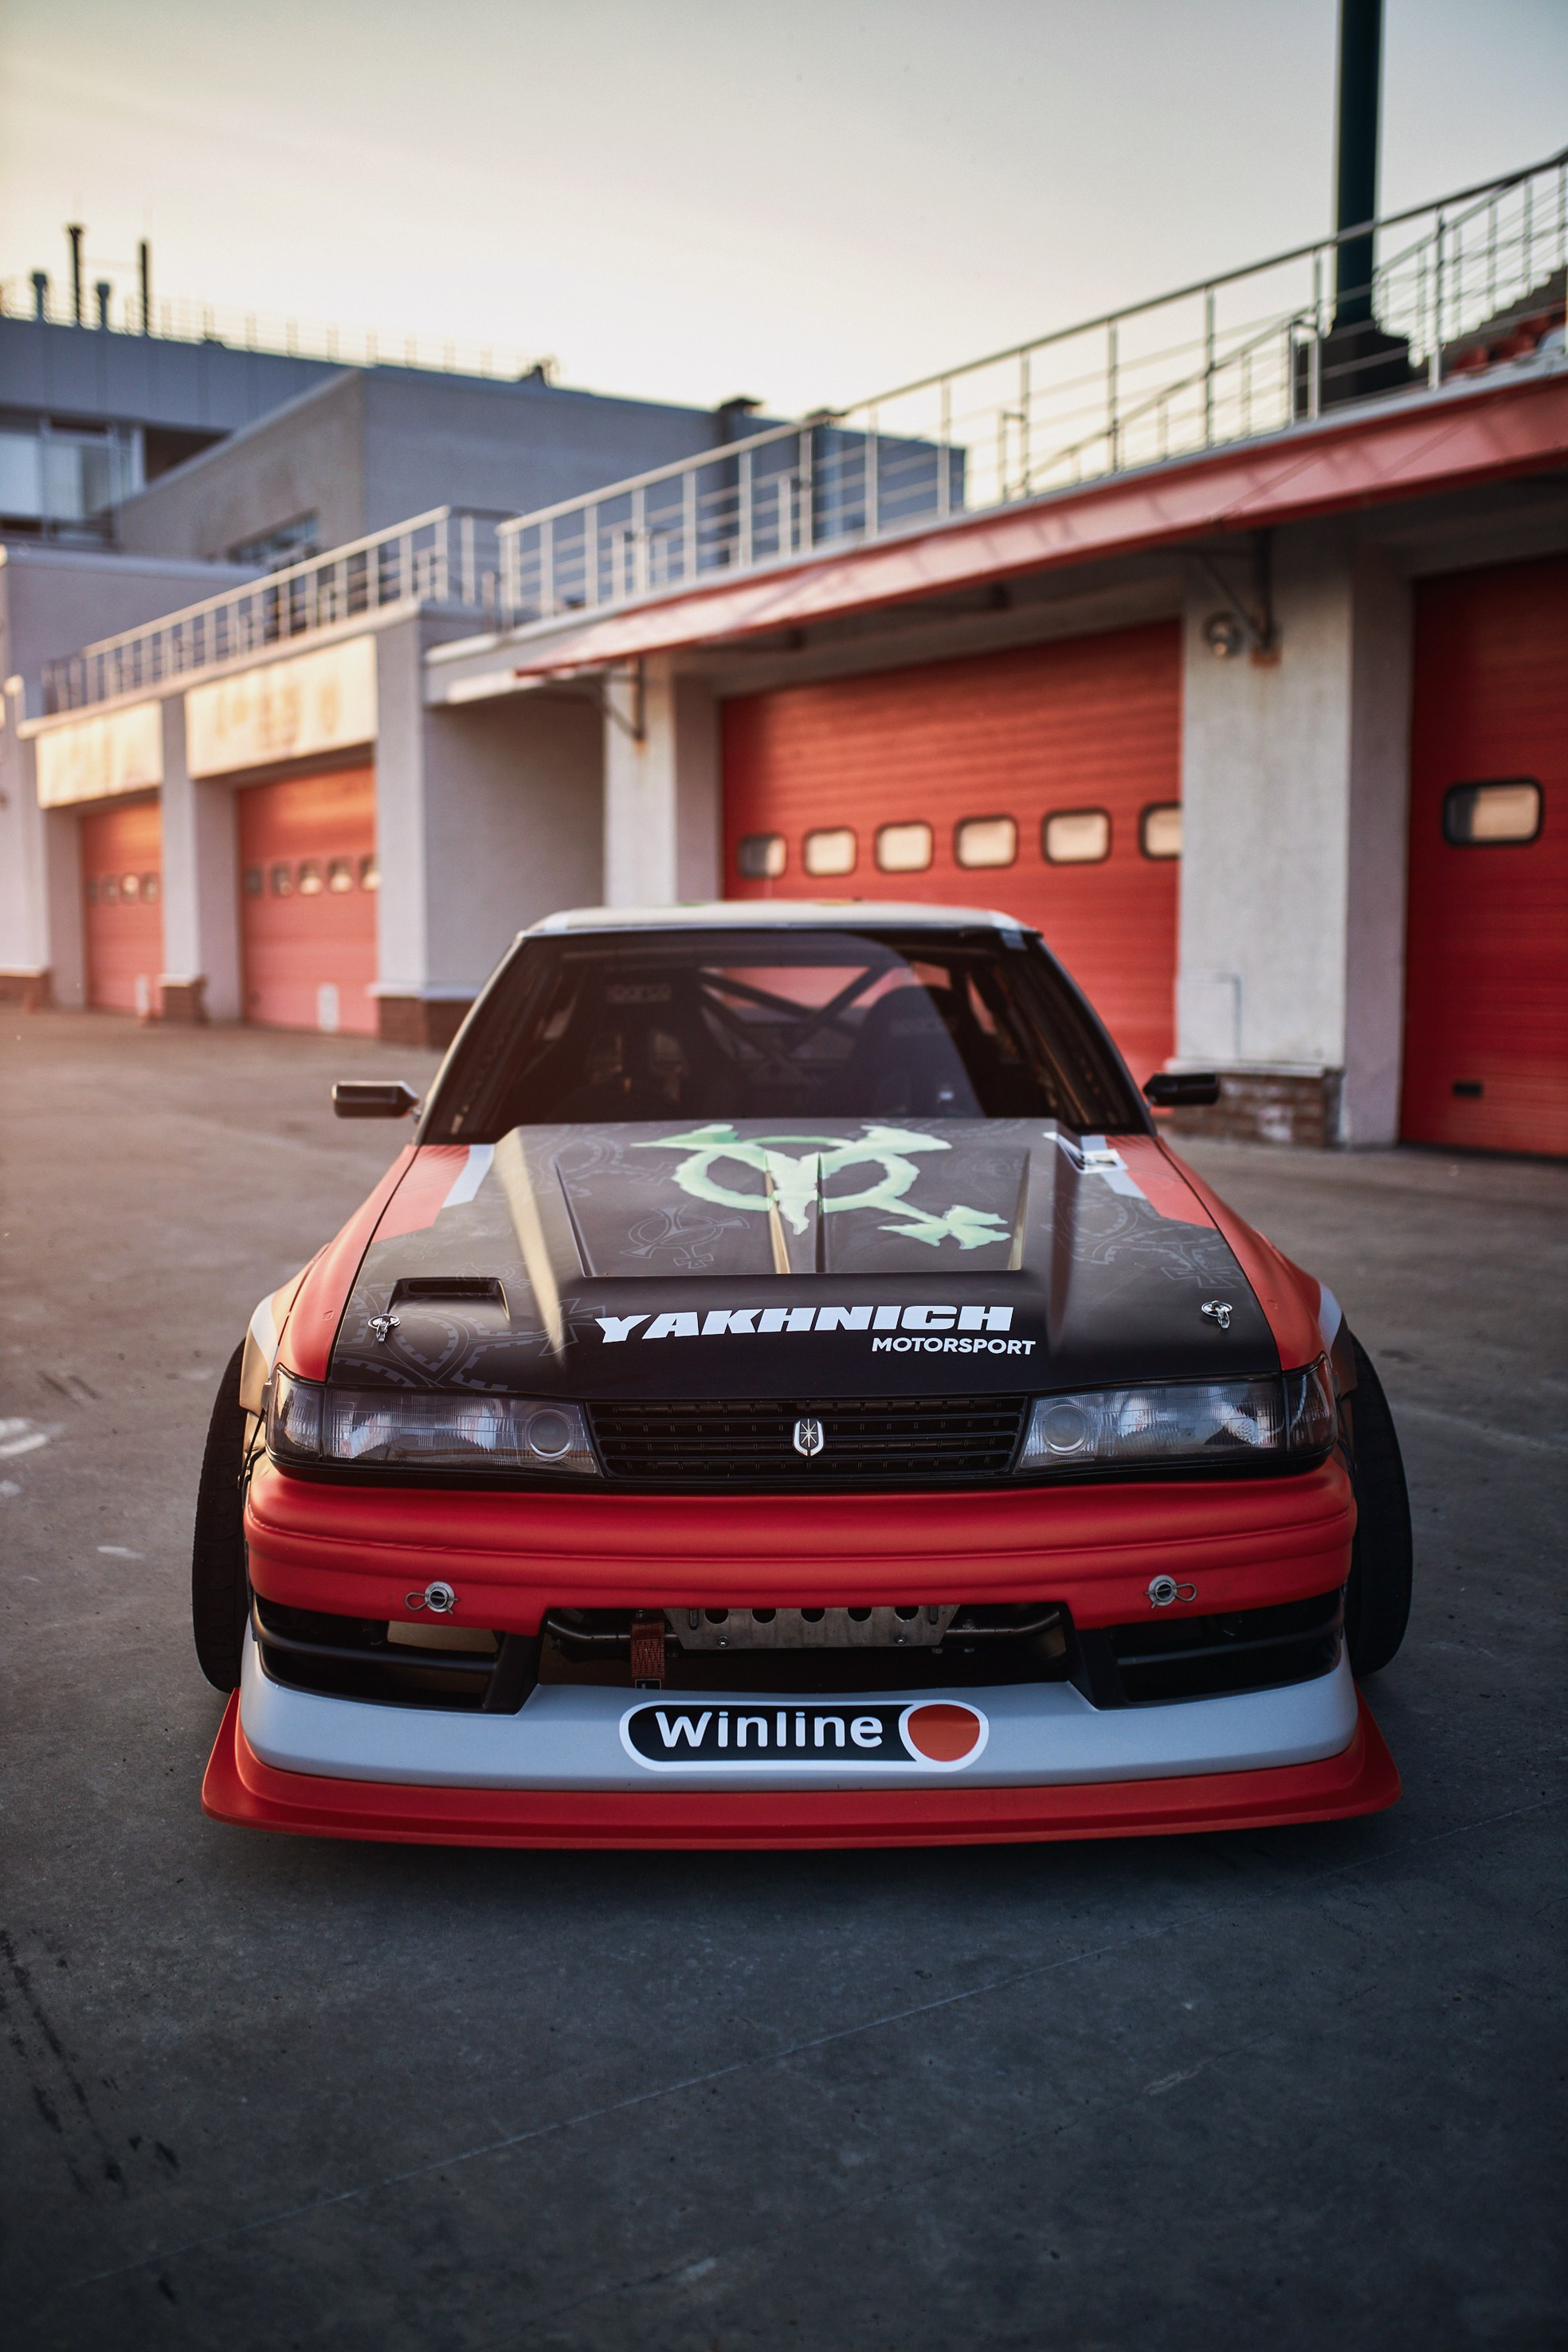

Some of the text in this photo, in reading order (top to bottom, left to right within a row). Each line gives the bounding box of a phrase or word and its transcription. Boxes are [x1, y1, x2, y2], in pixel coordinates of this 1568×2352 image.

[594, 1305, 1014, 1343] YAKHNICH
[872, 1337, 1037, 1355] MOTORSPORT
[655, 1711, 883, 1748] Winline
